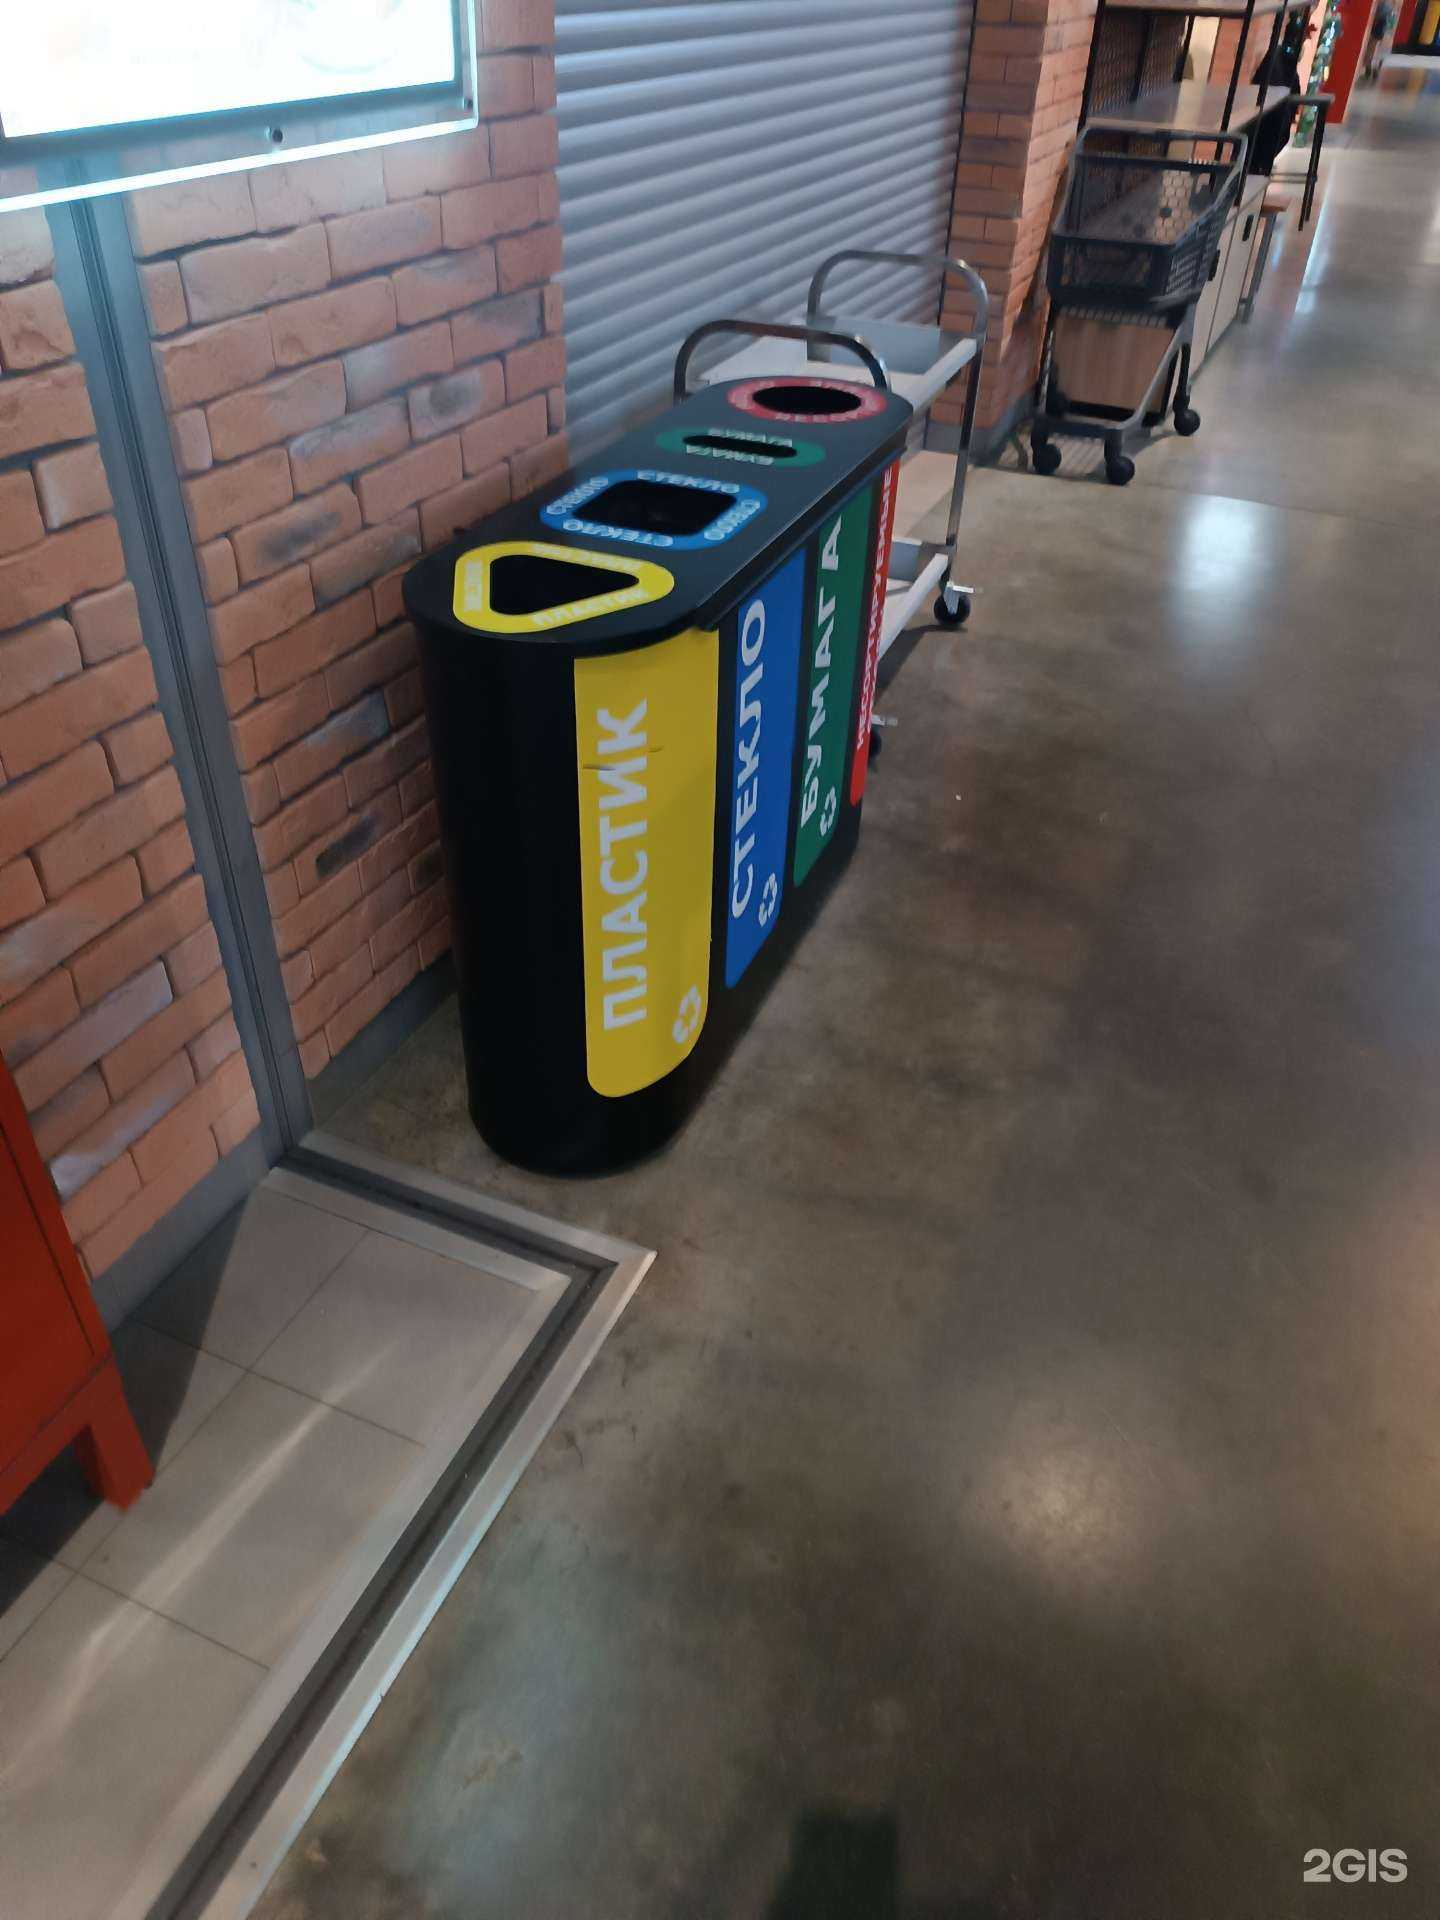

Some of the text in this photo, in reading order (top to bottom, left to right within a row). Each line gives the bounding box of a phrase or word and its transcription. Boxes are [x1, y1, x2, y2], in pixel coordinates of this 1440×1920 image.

[562, 518, 674, 547] СТЕКЛО
[799, 515, 842, 829] БУМАГА
[597, 698, 648, 1031] ПЛАСТИК
[730, 598, 767, 920] СТЕКЛО
